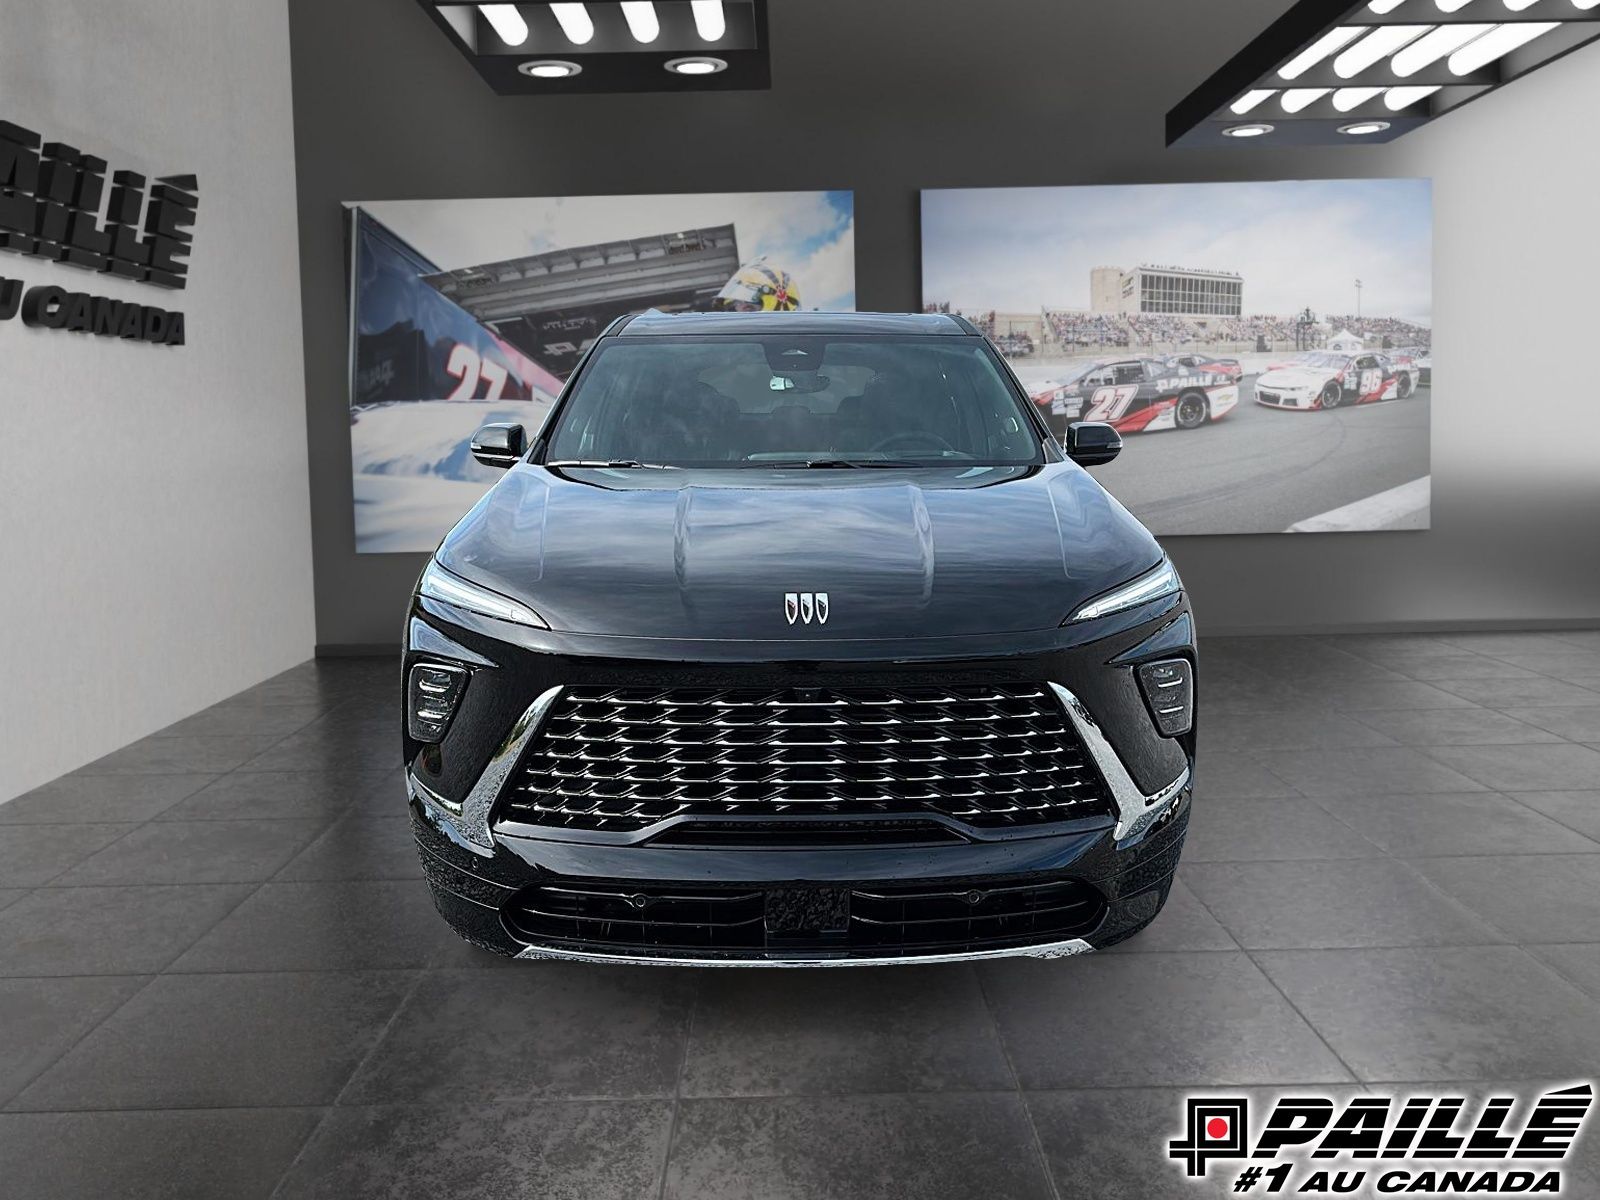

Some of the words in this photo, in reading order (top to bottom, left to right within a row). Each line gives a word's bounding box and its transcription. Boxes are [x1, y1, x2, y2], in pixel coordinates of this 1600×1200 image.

[21, 285, 185, 345] CANADA
[447, 343, 508, 401] 27
[1084, 384, 1139, 422] 27
